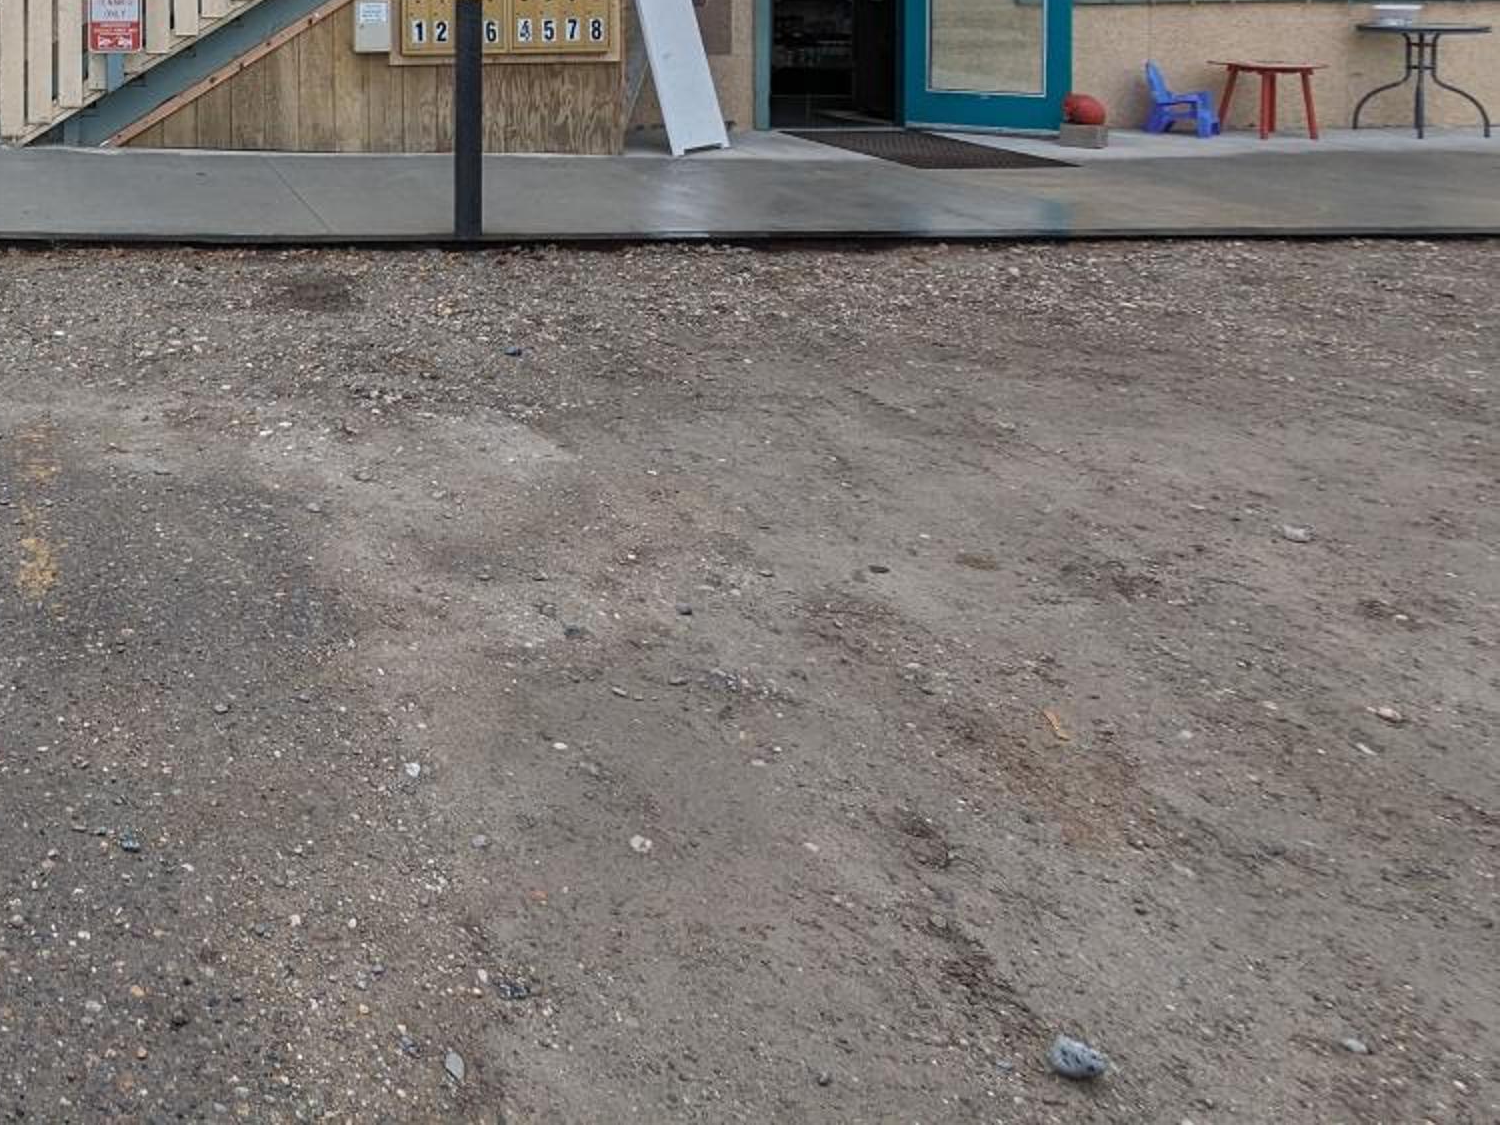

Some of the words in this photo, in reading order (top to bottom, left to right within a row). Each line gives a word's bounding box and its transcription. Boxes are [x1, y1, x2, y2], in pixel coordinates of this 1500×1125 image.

[414, 21, 424, 42] 1
[435, 21, 448, 42] 2
[485, 21, 497, 42] 6
[543, 20, 555, 40] 5
[567, 18, 578, 40] 7
[591, 18, 602, 40] 8
